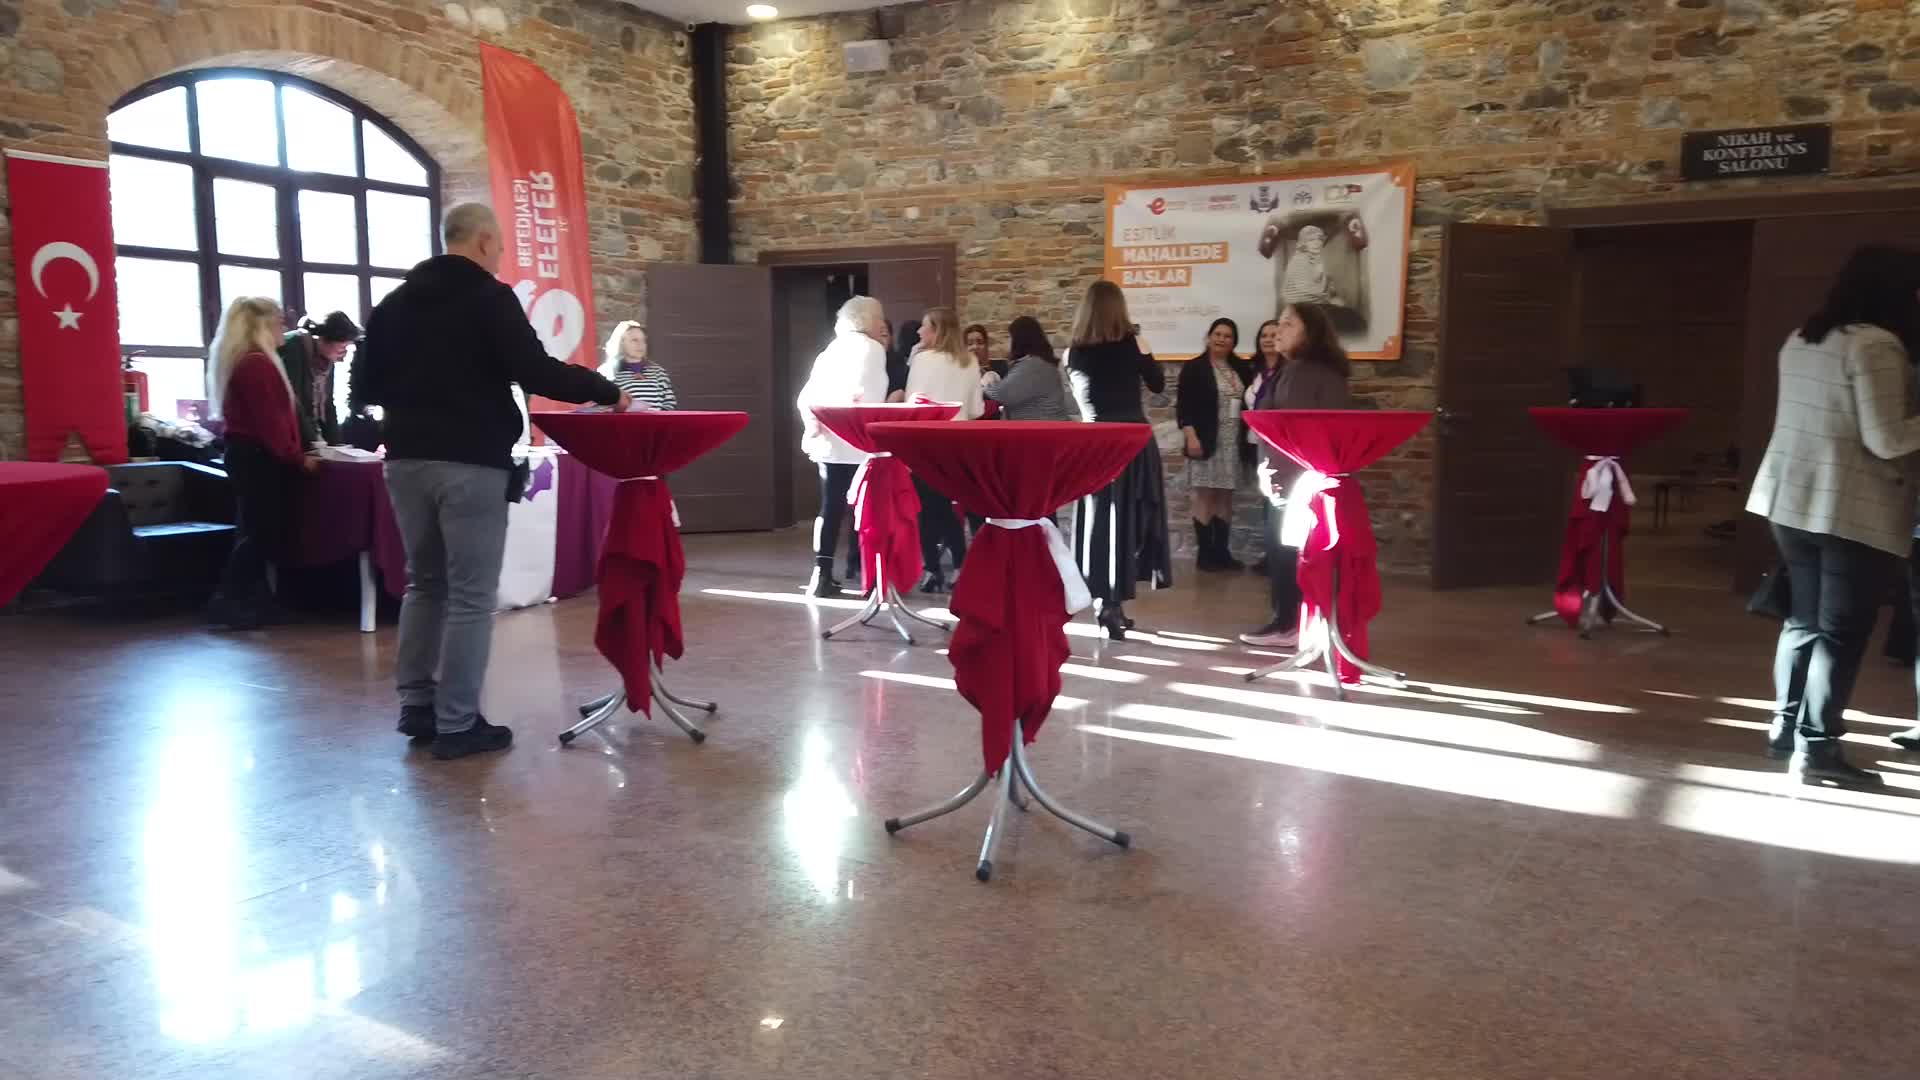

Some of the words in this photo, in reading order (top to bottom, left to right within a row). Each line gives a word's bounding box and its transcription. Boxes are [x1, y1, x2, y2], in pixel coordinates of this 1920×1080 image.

[1703, 143, 1808, 161] KONFERANS
[1718, 157, 1789, 173] SALONU
[1123, 245, 1223, 263] MAHALLEDE
